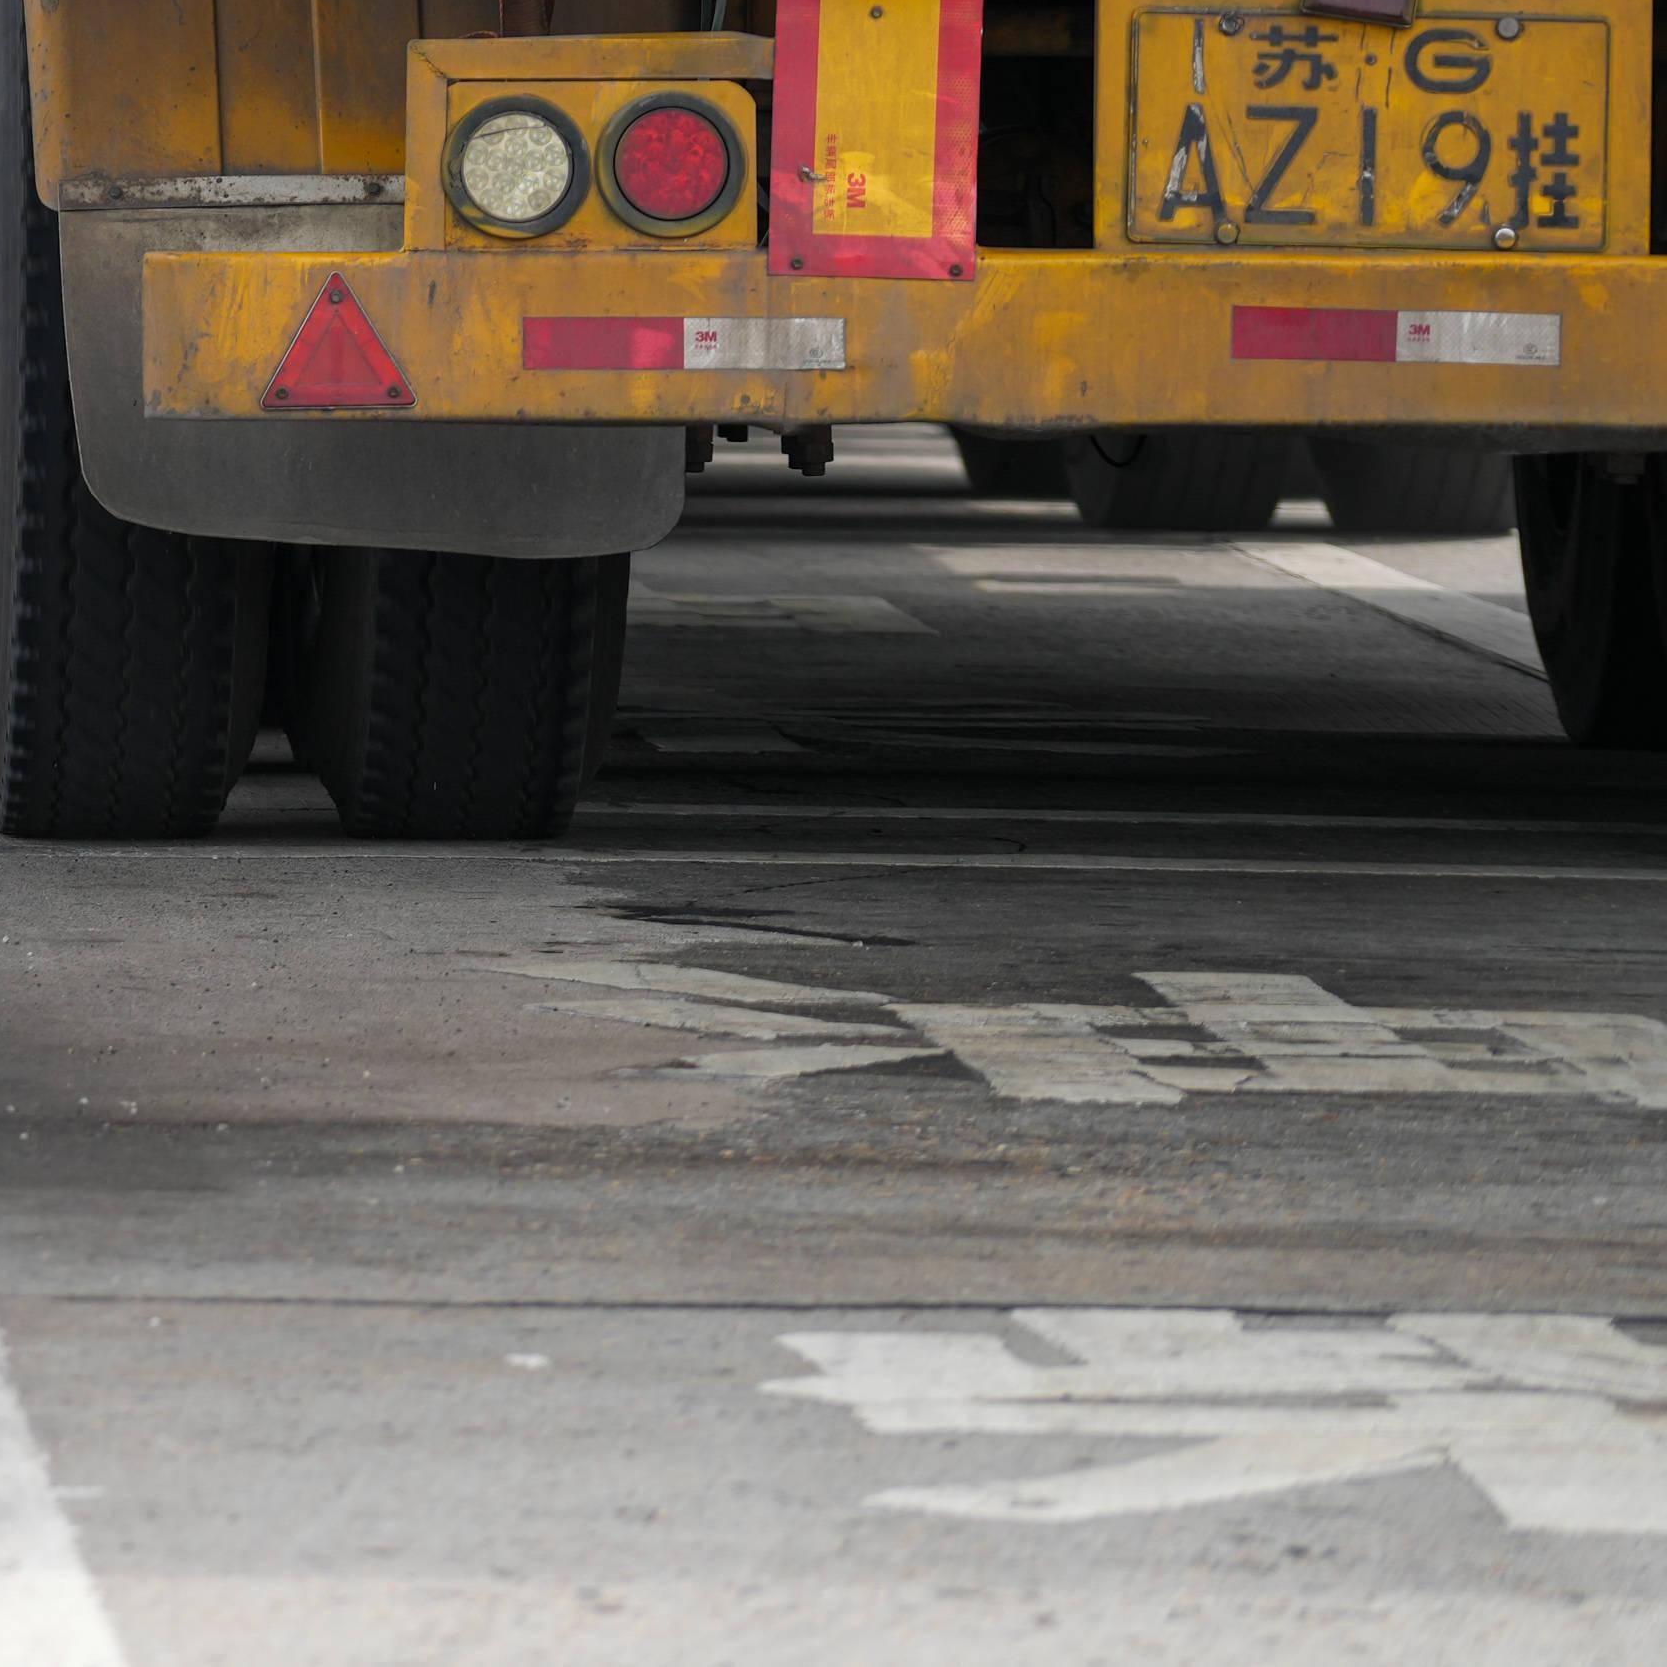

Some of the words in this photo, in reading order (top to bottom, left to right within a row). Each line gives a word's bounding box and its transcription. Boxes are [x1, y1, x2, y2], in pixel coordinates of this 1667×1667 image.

[1158, 102, 1581, 229] AZ19挂
[847, 172, 867, 209] 3M
[695, 331, 718, 342] 3M
[1408, 324, 1431, 335] 3M
